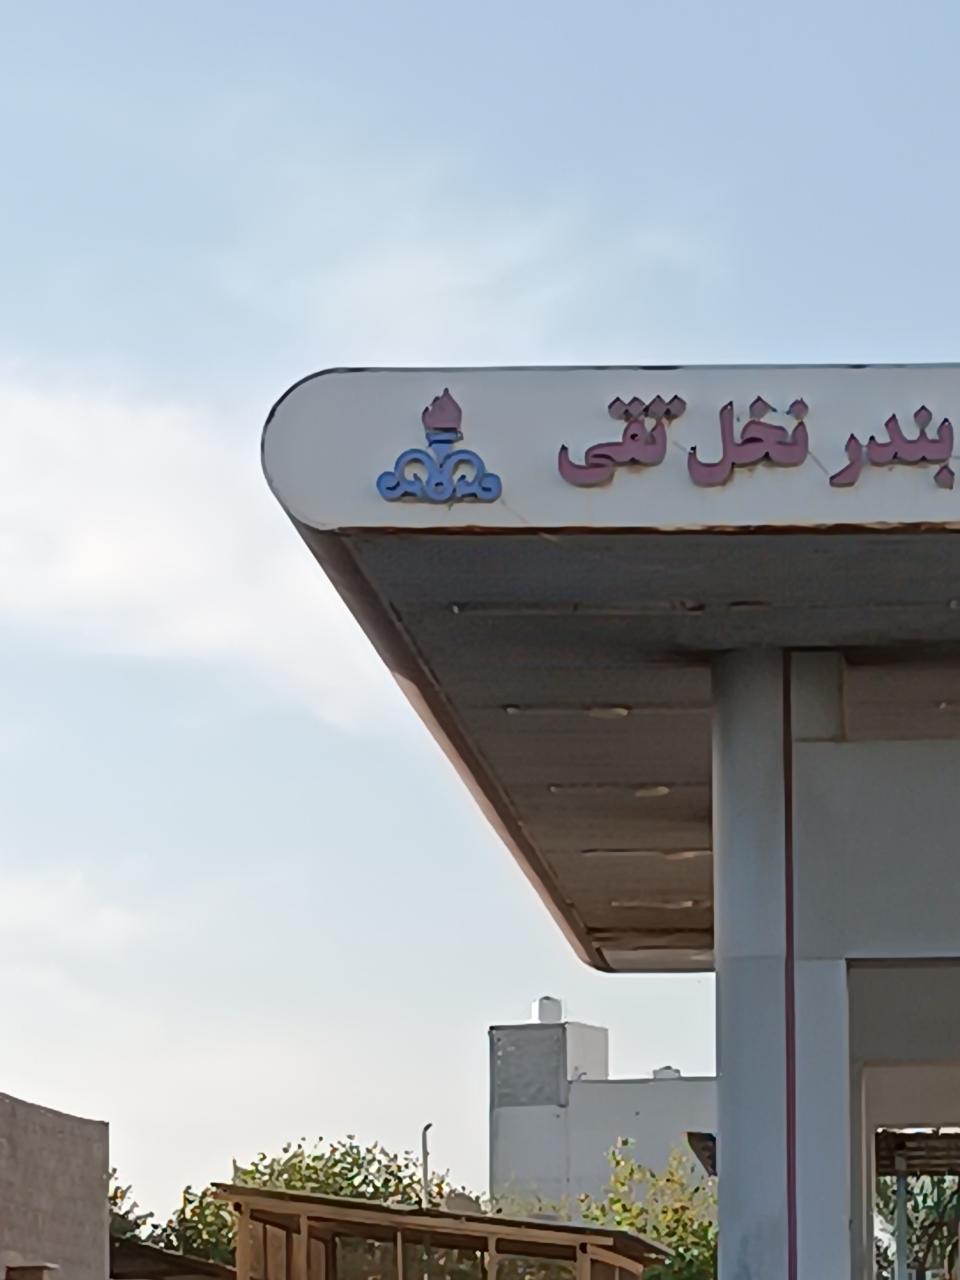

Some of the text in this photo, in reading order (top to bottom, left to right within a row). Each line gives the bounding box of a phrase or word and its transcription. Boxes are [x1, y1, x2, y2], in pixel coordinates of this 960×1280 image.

[558, 394, 687, 487] تقی
[687, 395, 809, 487] نخل
[829, 405, 954, 489] بندر
